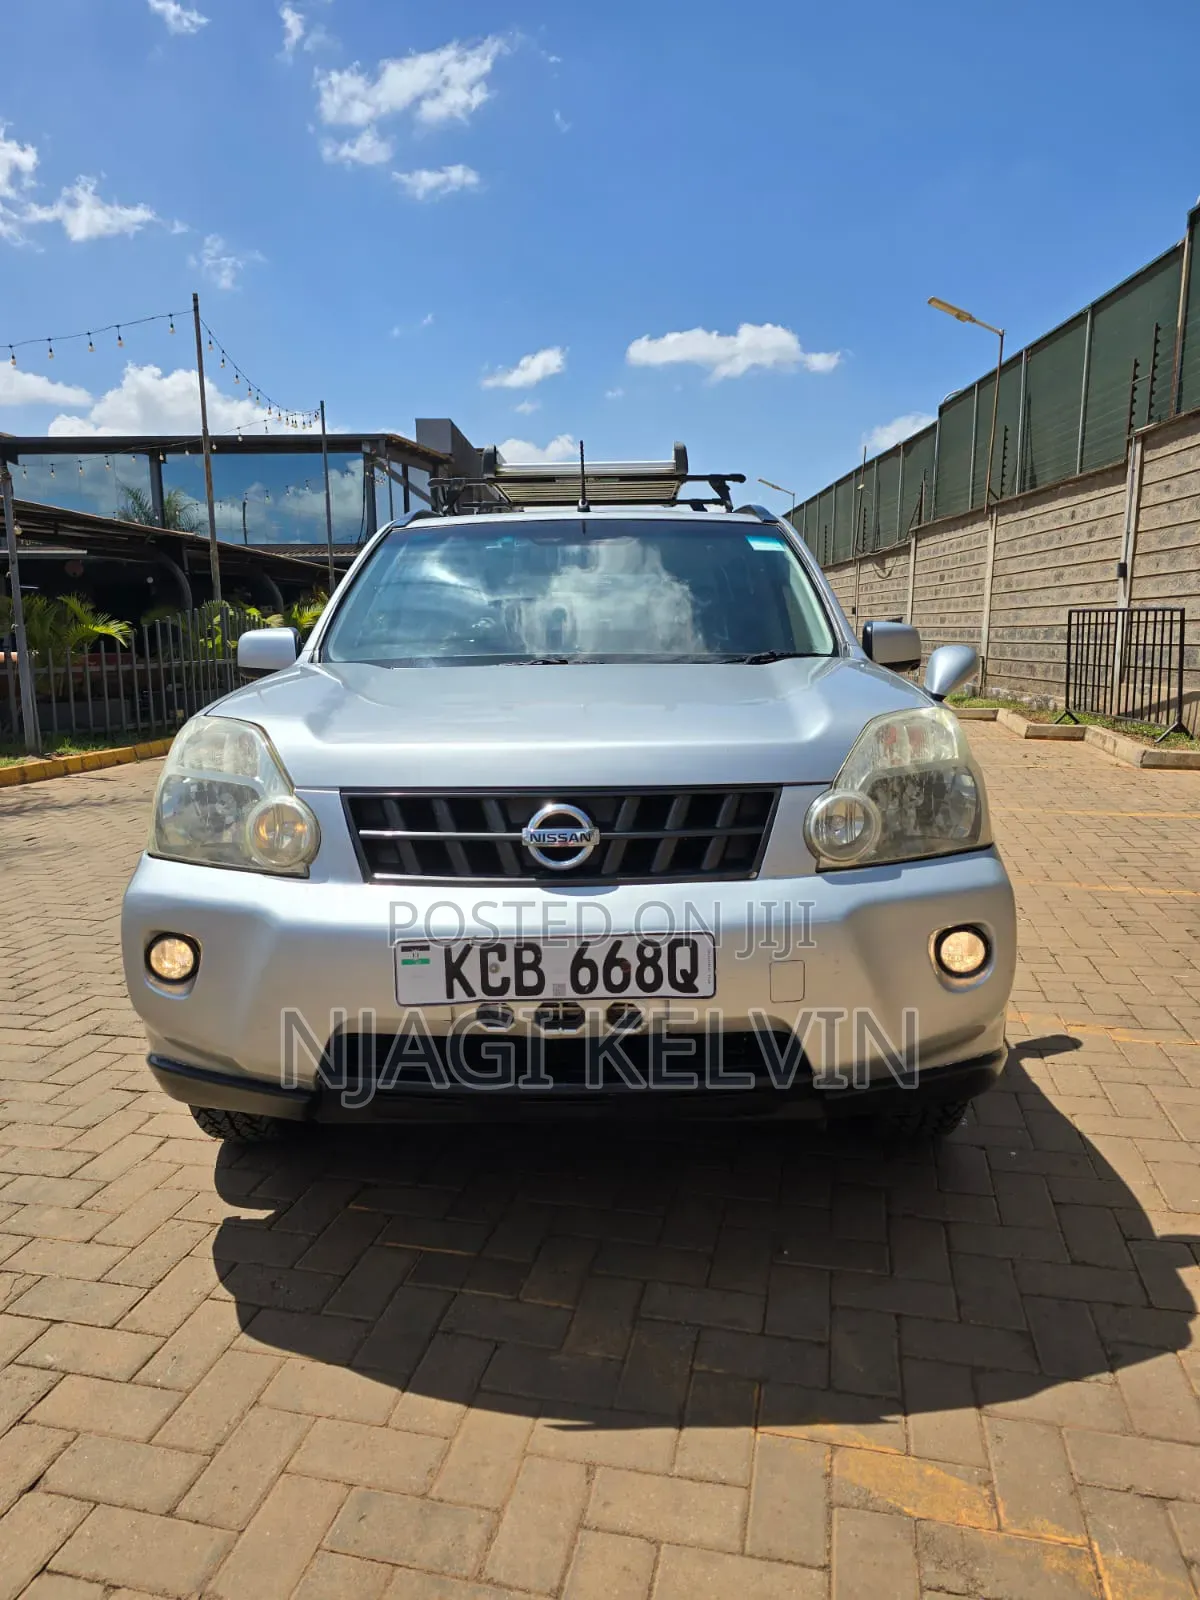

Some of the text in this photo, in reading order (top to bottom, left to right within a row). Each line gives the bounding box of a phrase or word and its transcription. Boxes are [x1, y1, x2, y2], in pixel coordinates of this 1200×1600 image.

[529, 832, 592, 843] NISSAN
[445, 943, 546, 999] KCB
[570, 938, 699, 994] 668Q
